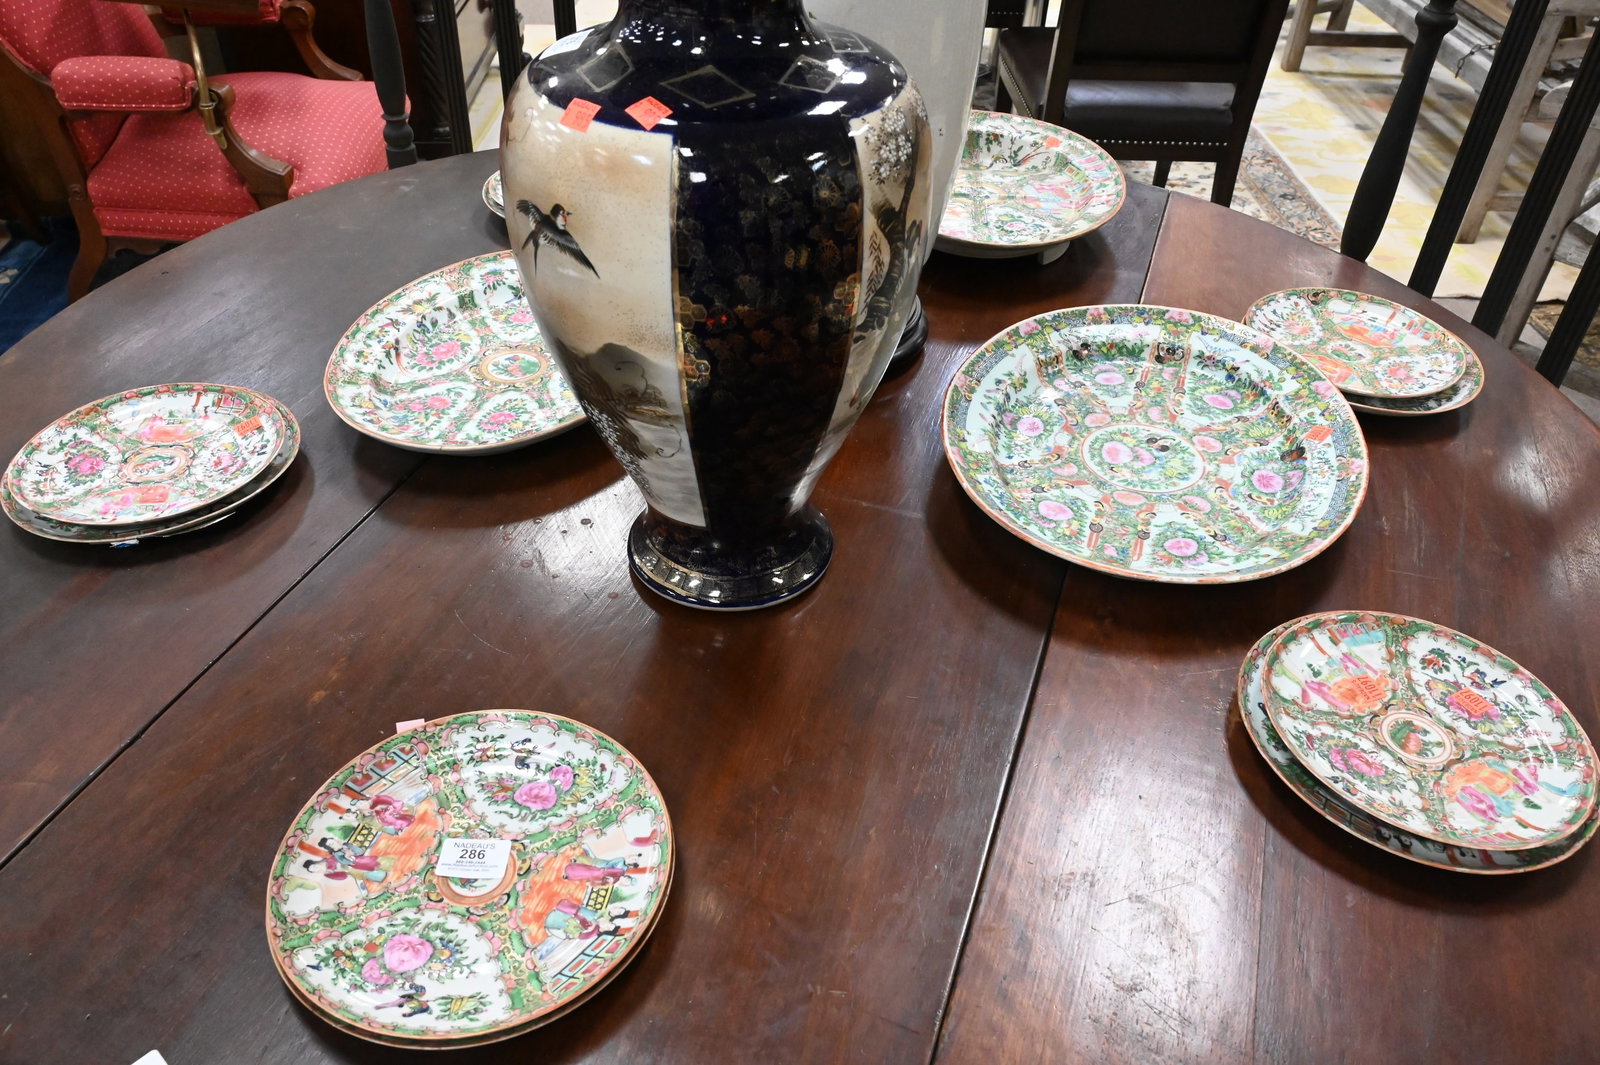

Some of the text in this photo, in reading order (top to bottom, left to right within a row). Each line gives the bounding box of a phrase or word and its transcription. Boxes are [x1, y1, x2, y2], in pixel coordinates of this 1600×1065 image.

[1357, 676, 1382, 698] 11097
[1459, 690, 1488, 710] 11097
[453, 841, 496, 850] NADEAU'S
[459, 849, 486, 860] 286
